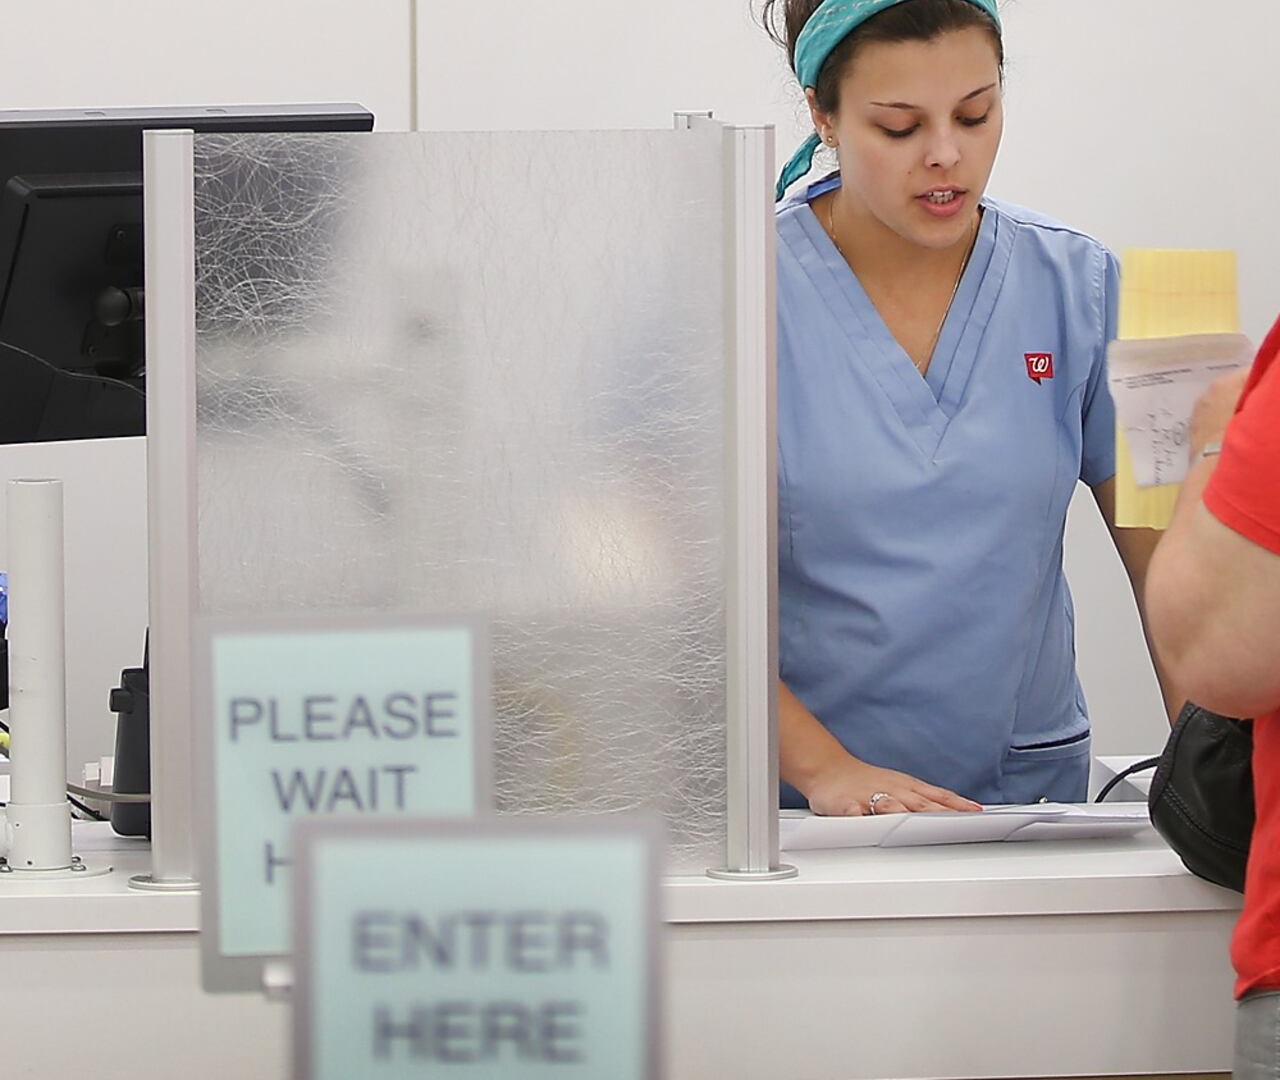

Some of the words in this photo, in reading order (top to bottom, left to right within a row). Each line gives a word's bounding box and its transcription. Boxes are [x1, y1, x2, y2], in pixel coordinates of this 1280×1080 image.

[228, 692, 460, 743] PLEASE
[269, 765, 418, 813] WAIT
[349, 908, 610, 975] ENTER
[369, 1001, 584, 1064] HERE
